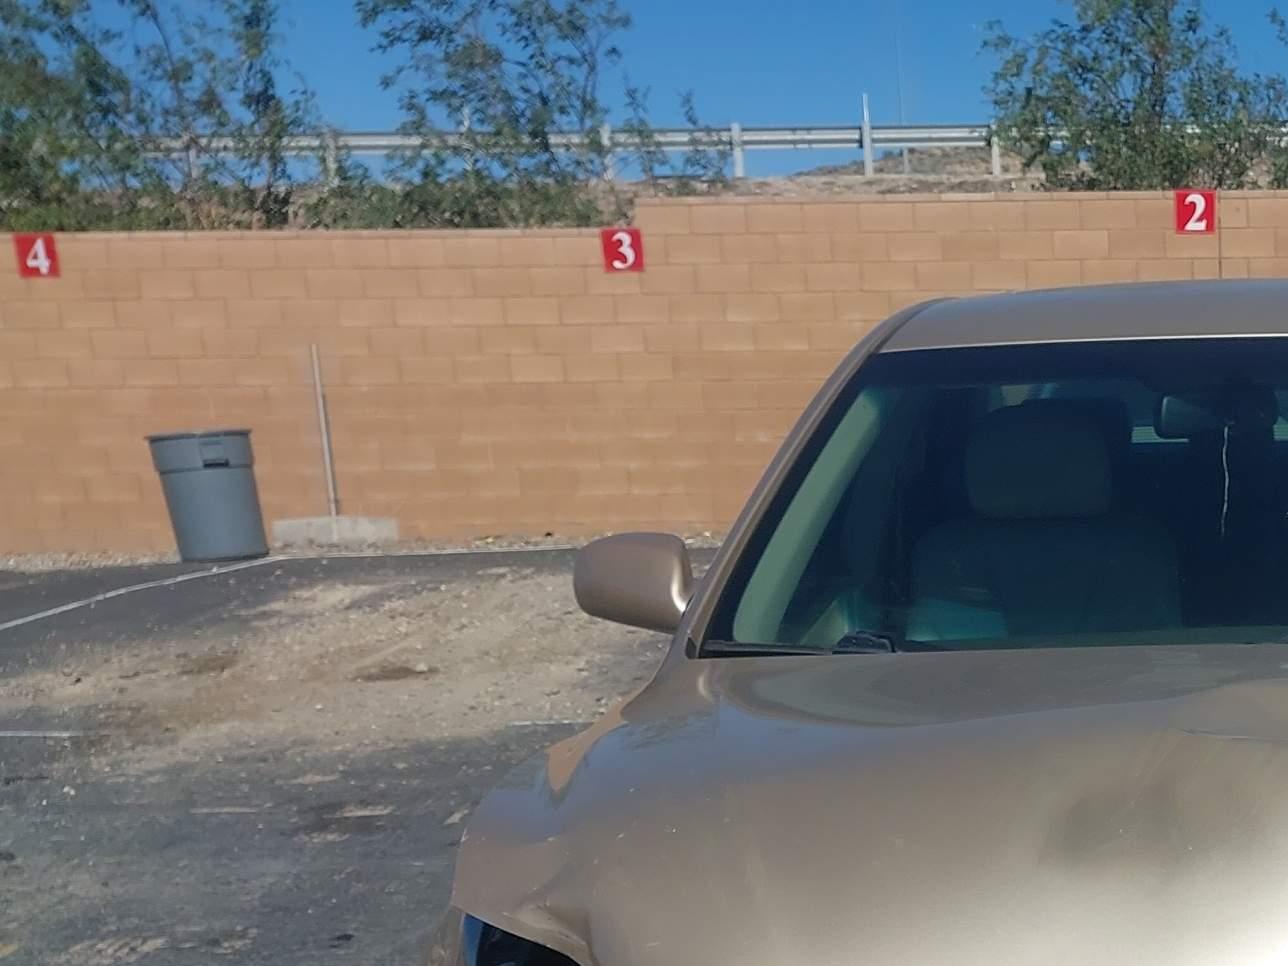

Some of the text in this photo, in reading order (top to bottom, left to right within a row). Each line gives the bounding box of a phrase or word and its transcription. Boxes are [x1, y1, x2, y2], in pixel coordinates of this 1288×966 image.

[1183, 193, 1208, 231] 2
[26, 238, 51, 275] 4
[611, 231, 636, 269] 3
